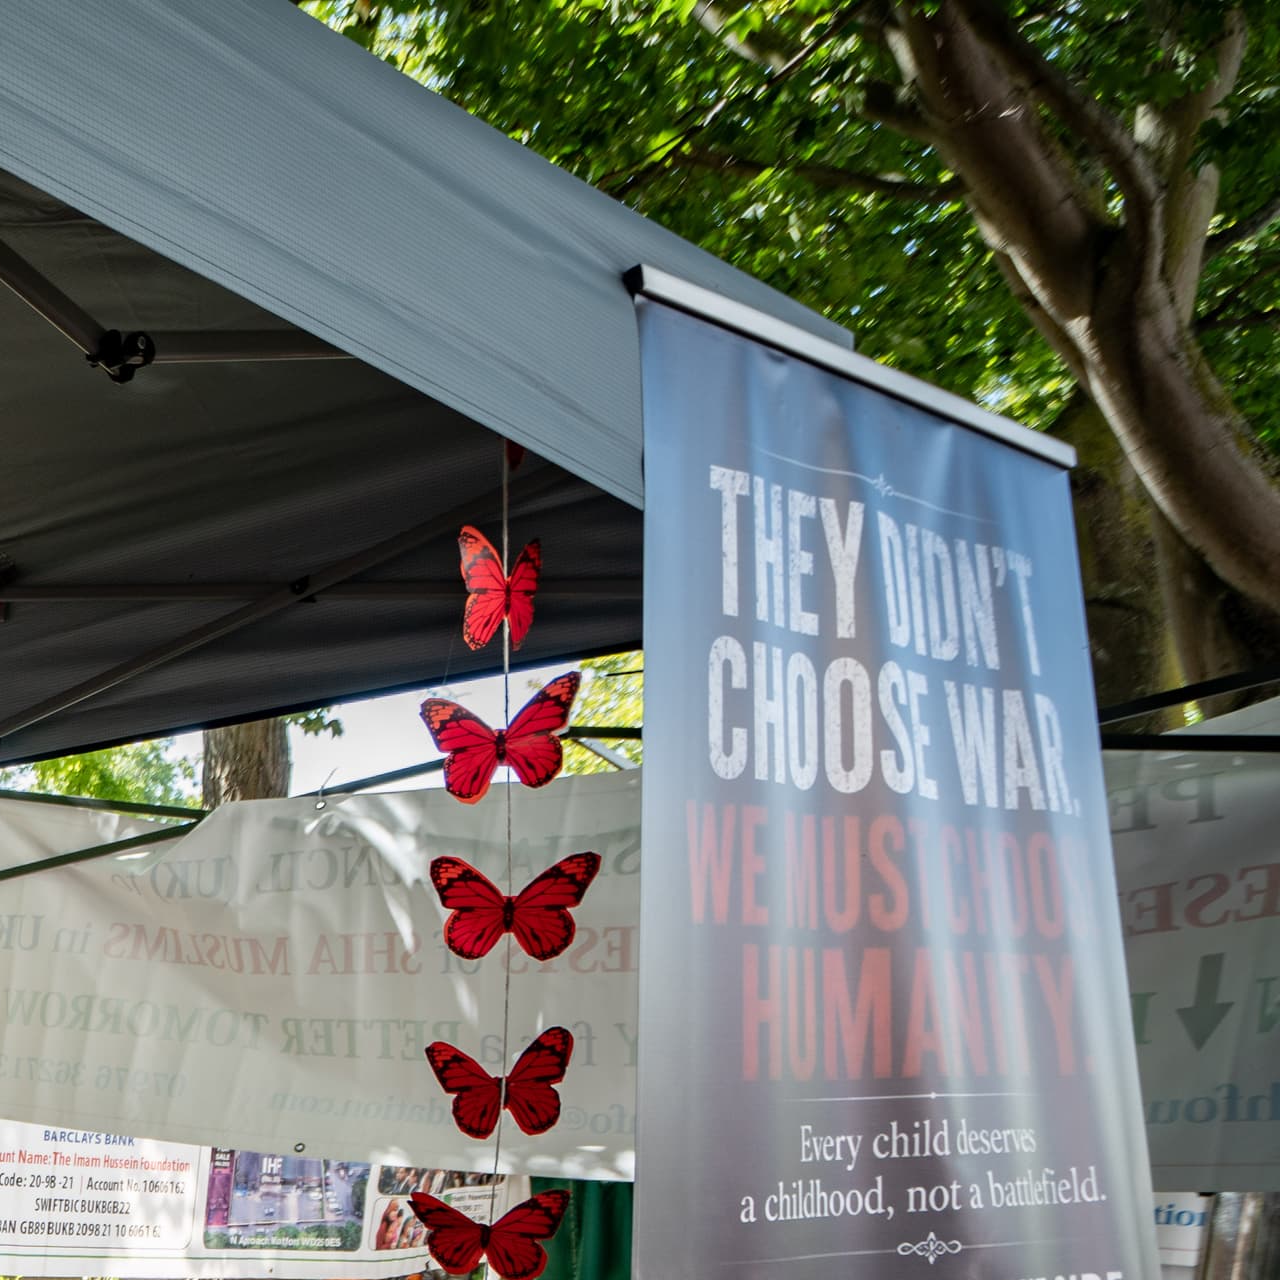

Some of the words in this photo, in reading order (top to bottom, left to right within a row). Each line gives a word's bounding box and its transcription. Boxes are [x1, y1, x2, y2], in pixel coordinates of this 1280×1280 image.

[710, 464, 865, 640] THEY
[877, 511, 1043, 677] DIDN'T
[708, 635, 939, 801] CHOOSE
[944, 680, 1083, 818] WAR.
[687, 800, 769, 926] WE
[785, 811, 933, 935] MUST
[18, 1149, 52, 1166] Name:
[52, 1150, 71, 1167] The
[73, 1153, 101, 1169] Imam
[103, 1156, 139, 1170] Hussein
[140, 1158, 191, 1173] Foundation
[43, 1129, 103, 1146] BARCLAYS
[104, 1133, 136, 1148] BANK
[800, 1122, 862, 1170] Every
[873, 1121, 951, 1160] child
[957, 1117, 1037, 1156] deserves
[86, 1176, 124, 1193] Account
[261, 1157, 283, 1174] IHF
[740, 1195, 756, 1224] a
[765, 1176, 896, 1222] childhood,
[906, 1180, 962, 1215] not
[970, 1182, 986, 1209] a
[990, 1166, 1108, 1209] battlefield.
